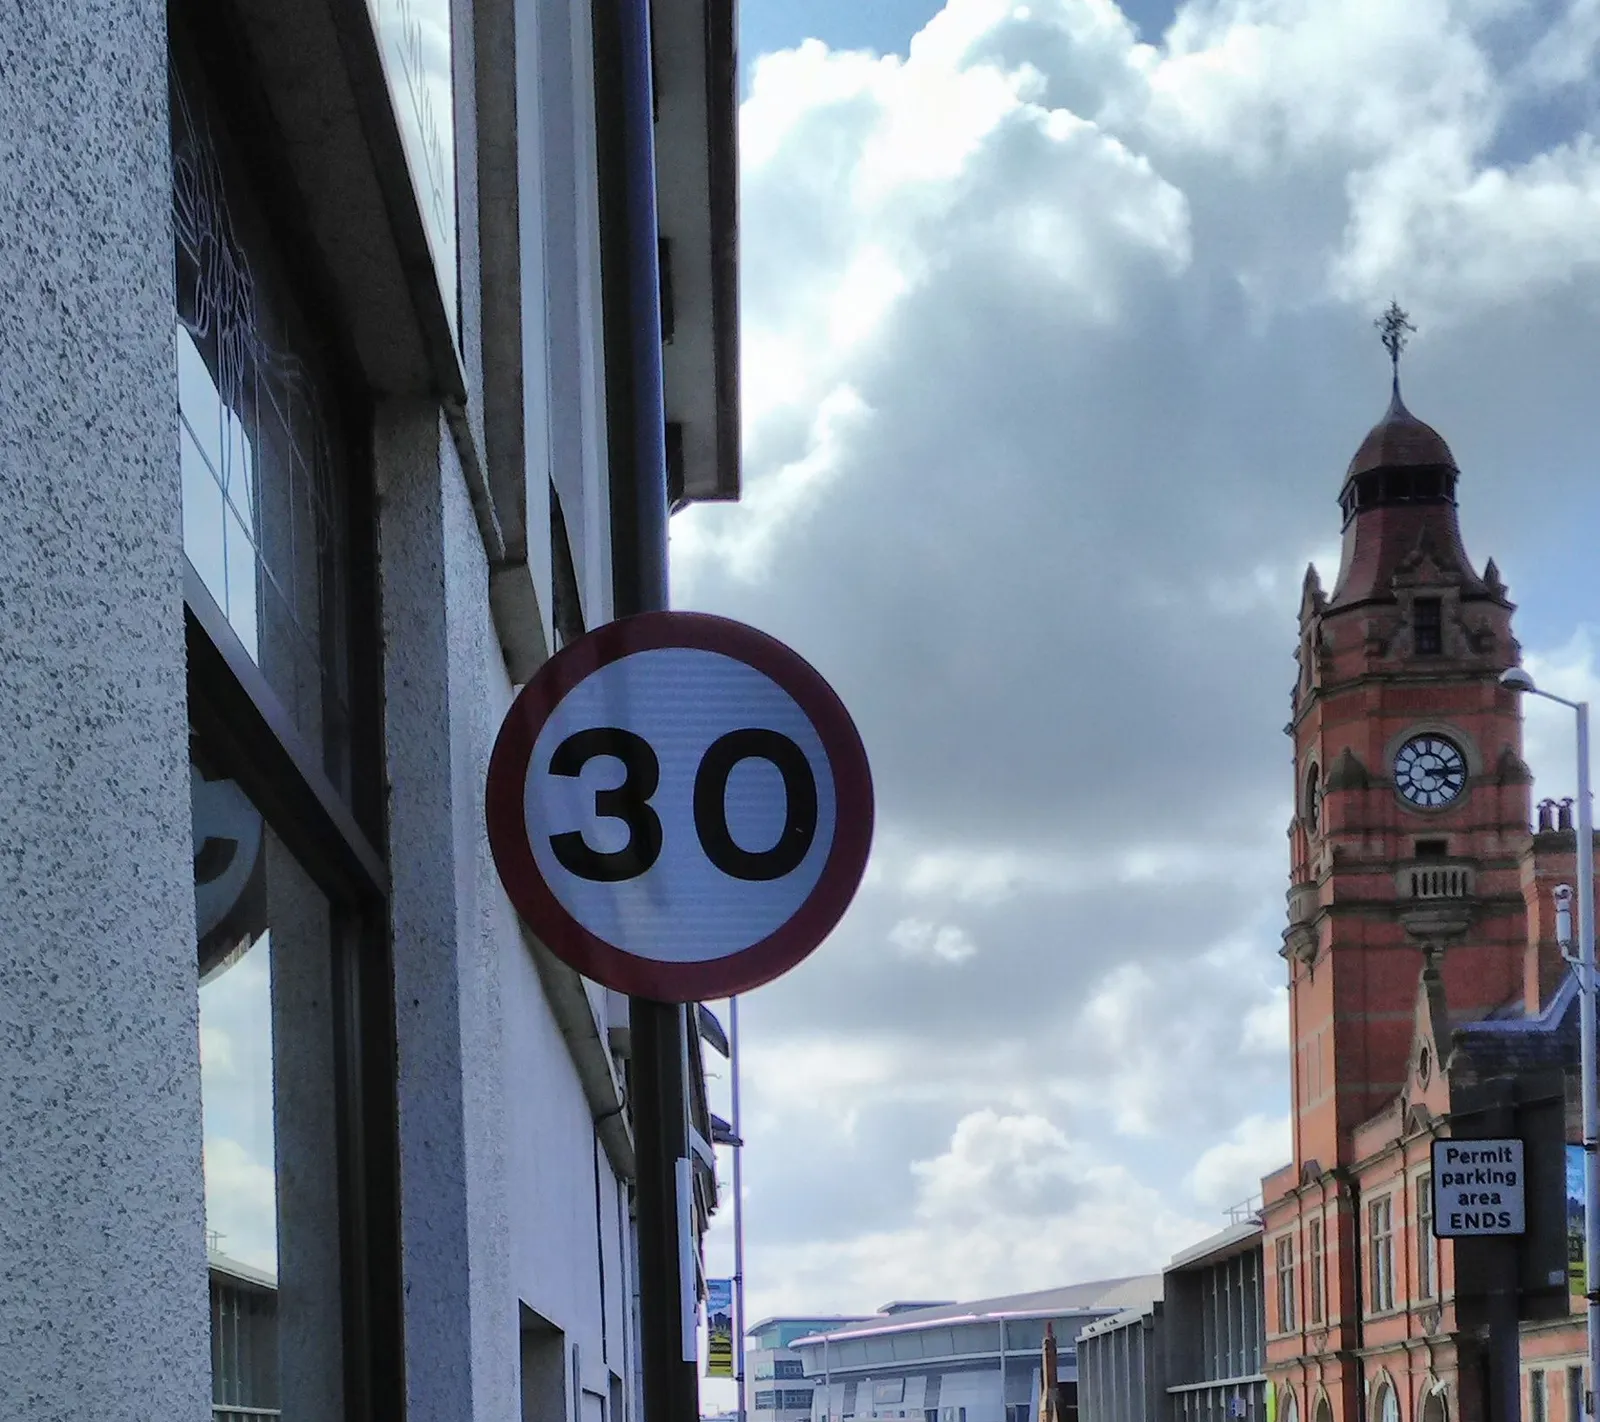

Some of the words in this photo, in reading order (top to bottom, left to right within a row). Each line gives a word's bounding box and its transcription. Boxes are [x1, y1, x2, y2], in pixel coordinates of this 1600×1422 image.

[548, 727, 818, 882] 30
[1446, 1147, 1513, 1164] Permit
[1441, 1168, 1517, 1188] parking
[1458, 1192, 1502, 1206] area
[1450, 1212, 1512, 1229] ENDS
